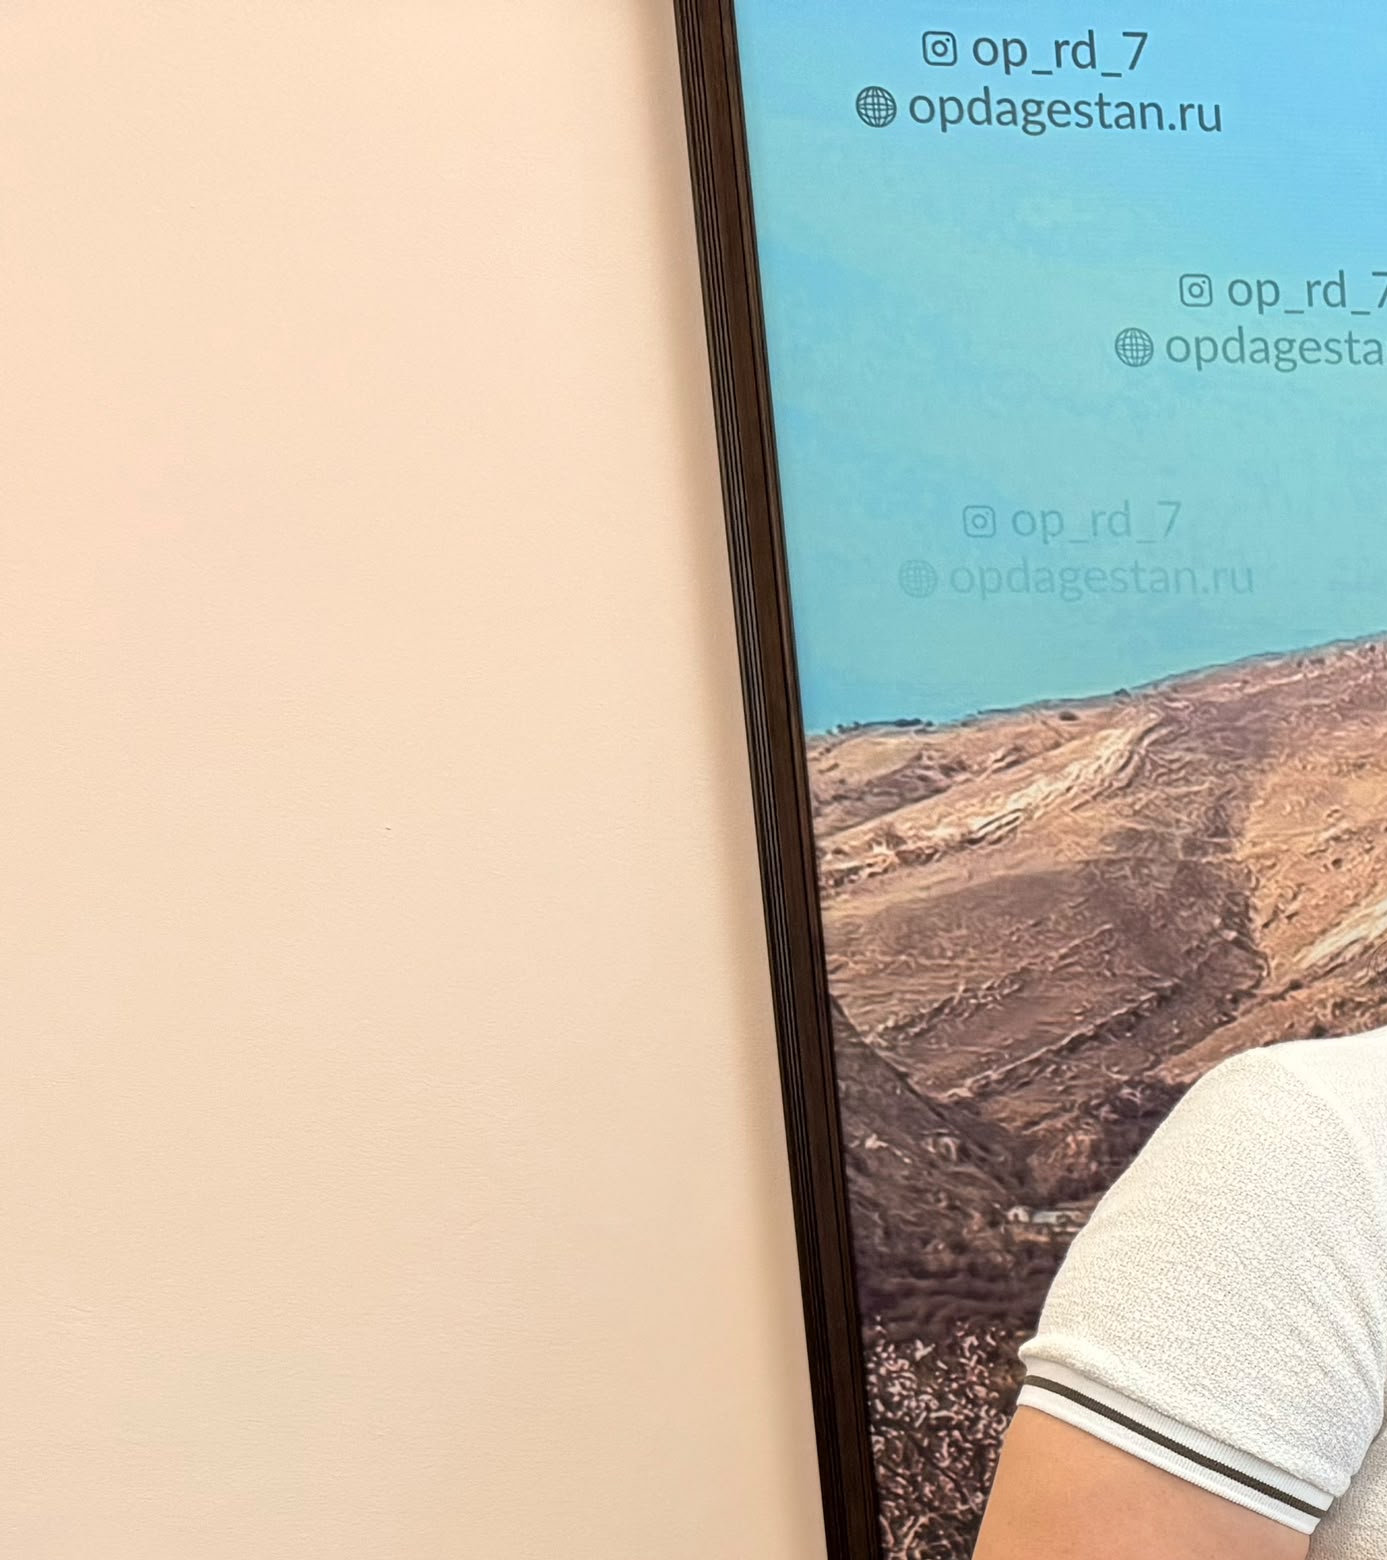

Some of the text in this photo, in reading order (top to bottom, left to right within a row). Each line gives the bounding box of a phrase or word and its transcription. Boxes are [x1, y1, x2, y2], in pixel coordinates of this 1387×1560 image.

[973, 29, 1149, 77] op_rd_7
[908, 86, 1222, 136] opdagestan.ru
[1011, 500, 1183, 542] op_rd_7
[949, 556, 1255, 601] opdagestan.ru
